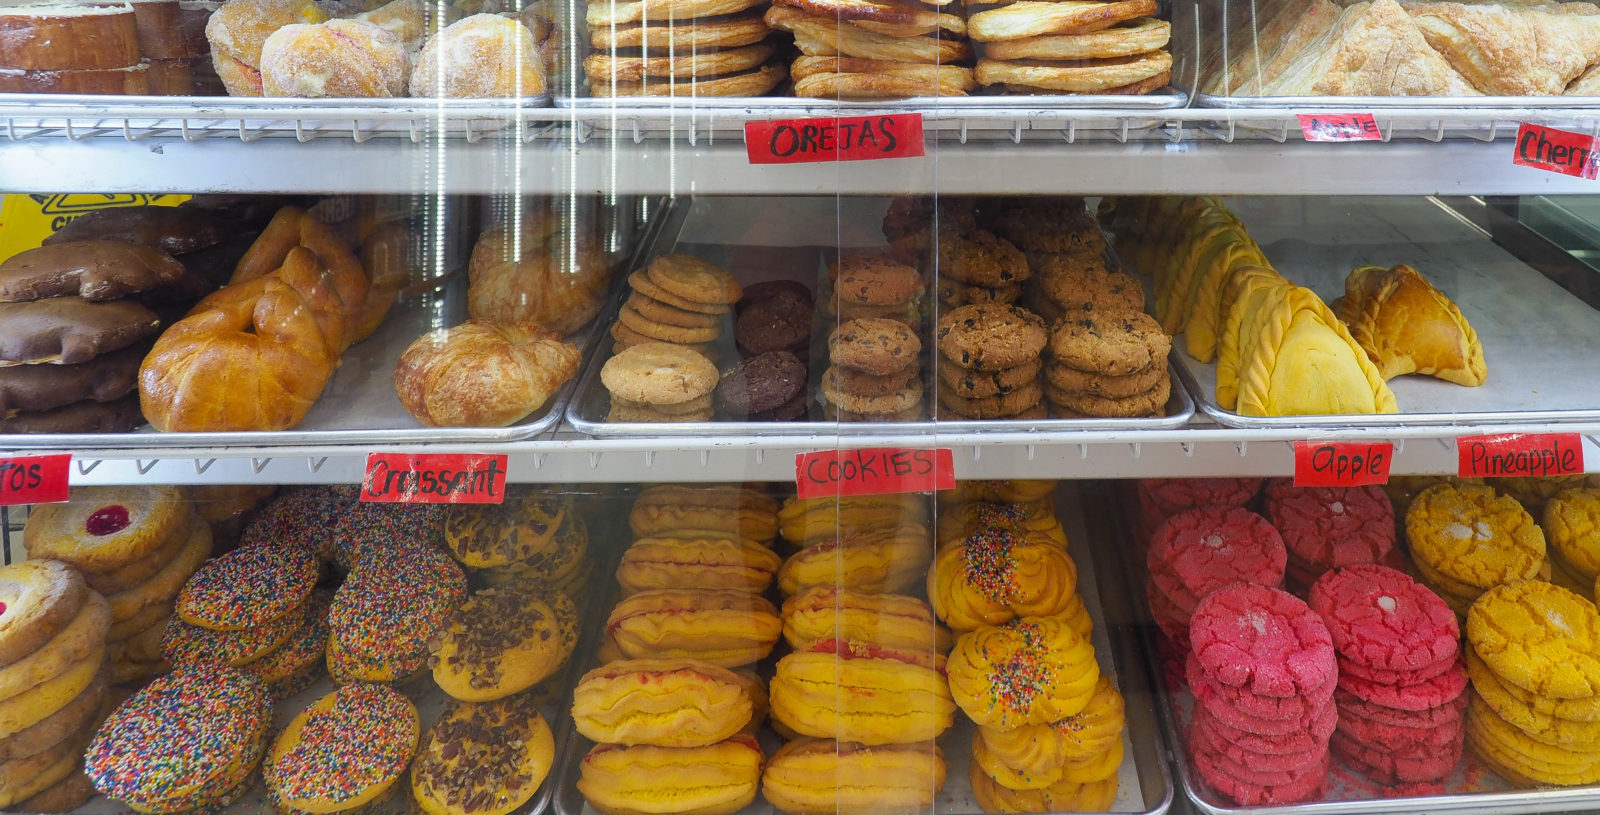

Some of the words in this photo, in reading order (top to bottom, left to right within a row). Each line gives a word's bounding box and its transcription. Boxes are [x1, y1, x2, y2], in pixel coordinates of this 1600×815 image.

[770, 117, 897, 157] OREJAS
[807, 449, 934, 484] COOKIES
[1471, 440, 1577, 477] Pineapple
[367, 459, 505, 498] Croissant
